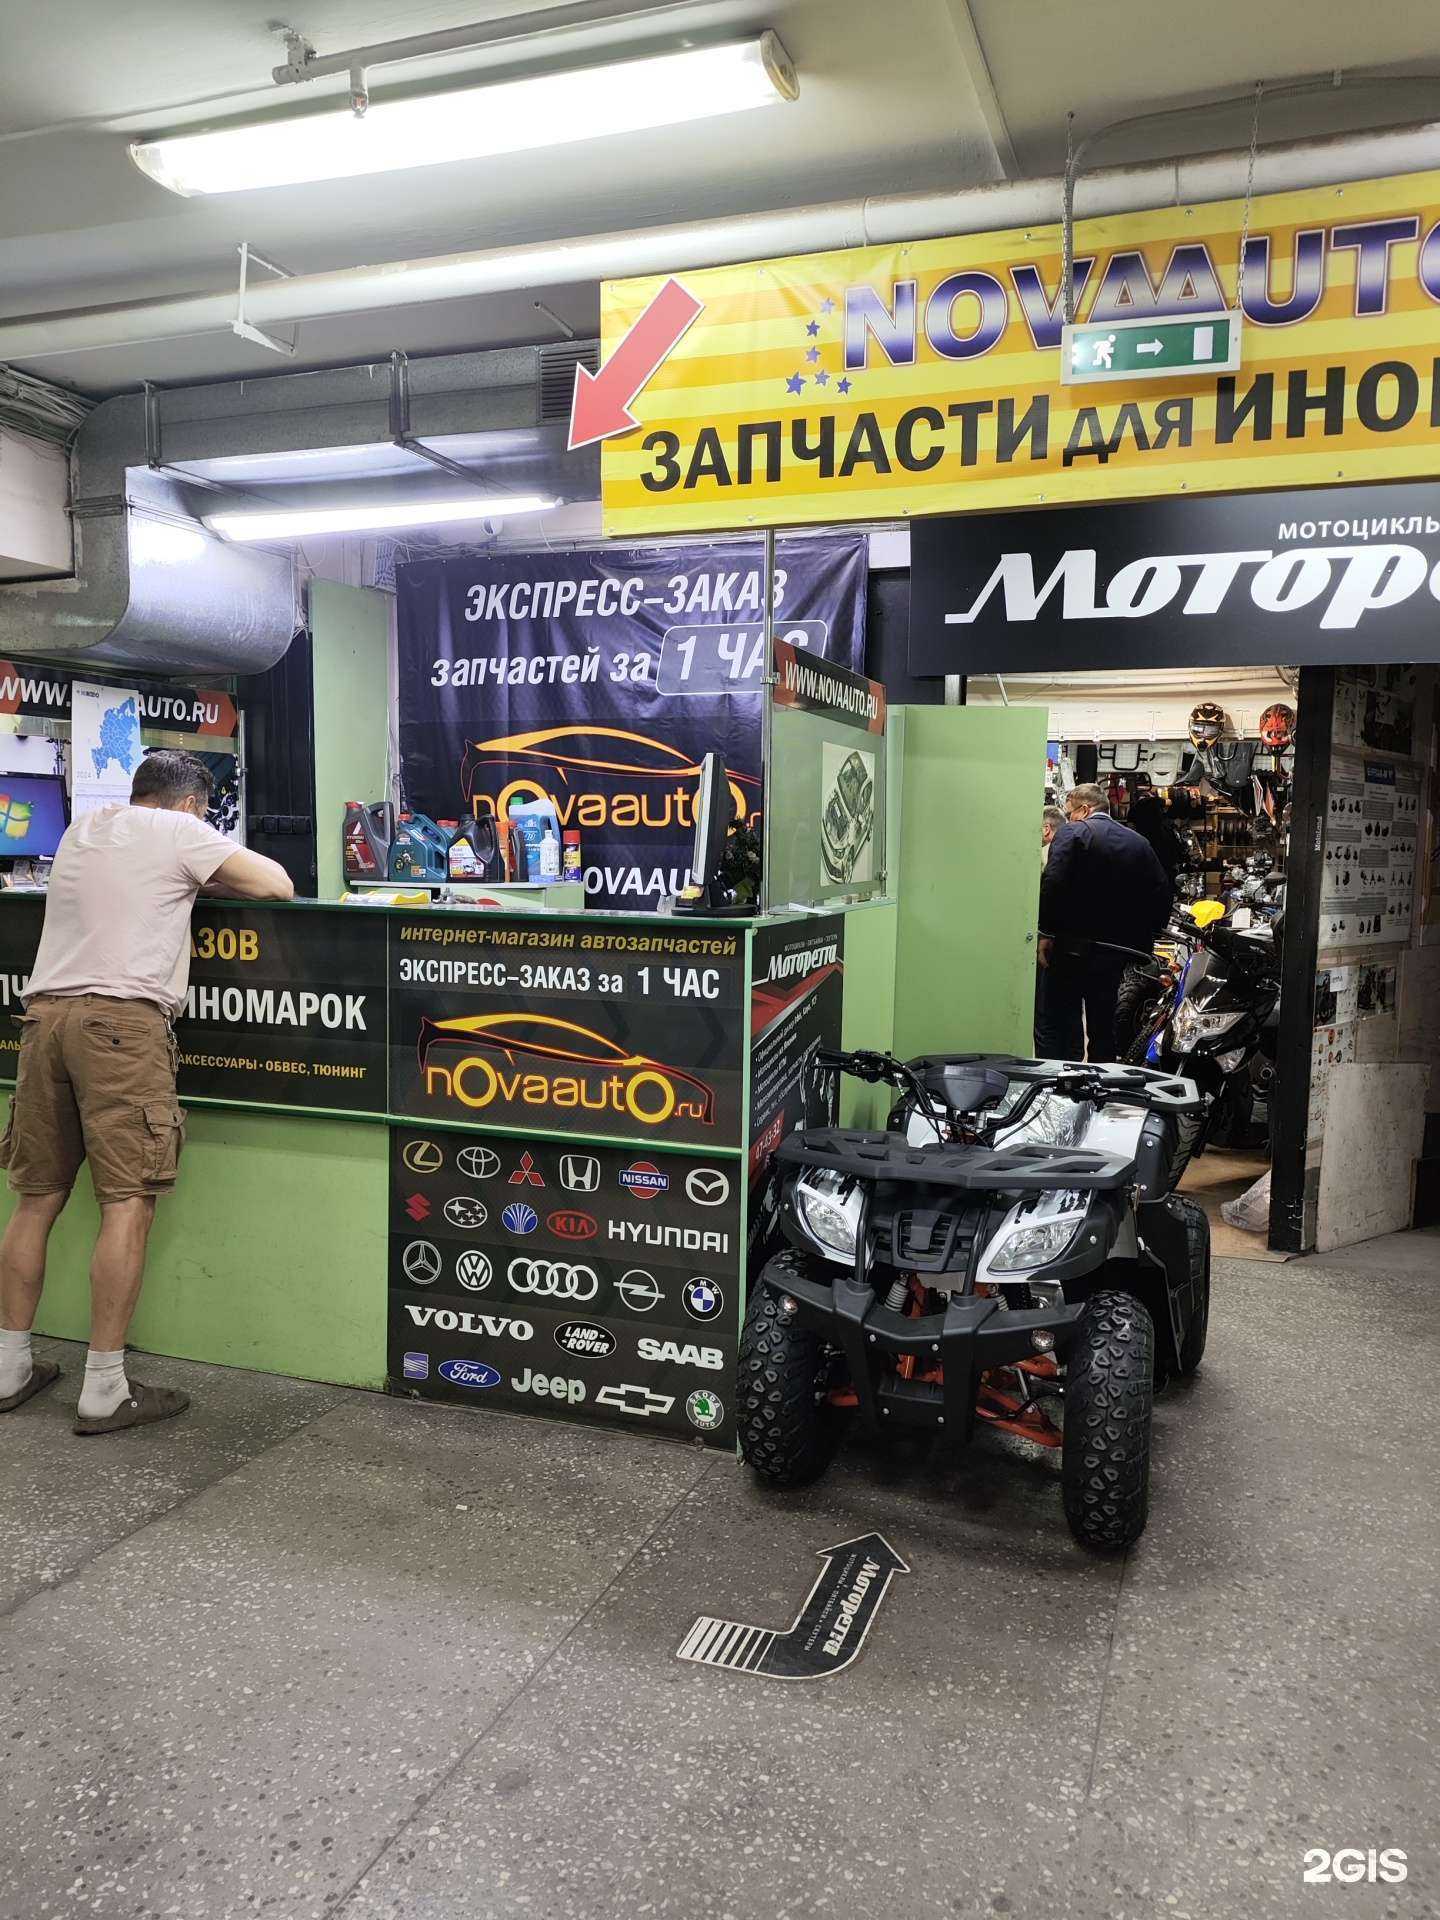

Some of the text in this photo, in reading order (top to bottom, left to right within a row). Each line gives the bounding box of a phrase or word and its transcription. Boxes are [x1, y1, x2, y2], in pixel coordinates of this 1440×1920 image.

[843, 215, 1440, 371] NOVAAUT
[640, 394, 1050, 492] ЗАПЧАСТИ
[1215, 357, 1440, 444] ИНО
[945, 544, 1440, 630] Мотор
[430, 647, 600, 687] запчастей
[609, 652, 652, 682] за
[677, 636, 697, 680] 1
[785, 660, 878, 720] WWW.NOVAAUTO.RU
[400, 926, 736, 956] интернет-магазин автозапчастей
[598, 975, 623, 994] за
[637, 969, 650, 995] 1
[663, 967, 720, 999] ЧАС
[180, 985, 367, 1031] ИНОМАРОК
[178, 1054, 257, 1071] АКСЕССУАРЫ
[313, 1063, 367, 1079] ТЮНИНГ
[622, 1173, 667, 1187] NISSAN
[555, 1216, 590, 1235] KIA
[608, 1220, 729, 1254] HYUNDAI
[404, 1304, 534, 1341] VOLVO
[637, 1338, 724, 1370] SAAB
[450, 1365, 488, 1385] Ford
[511, 1368, 586, 1404] Jeep
